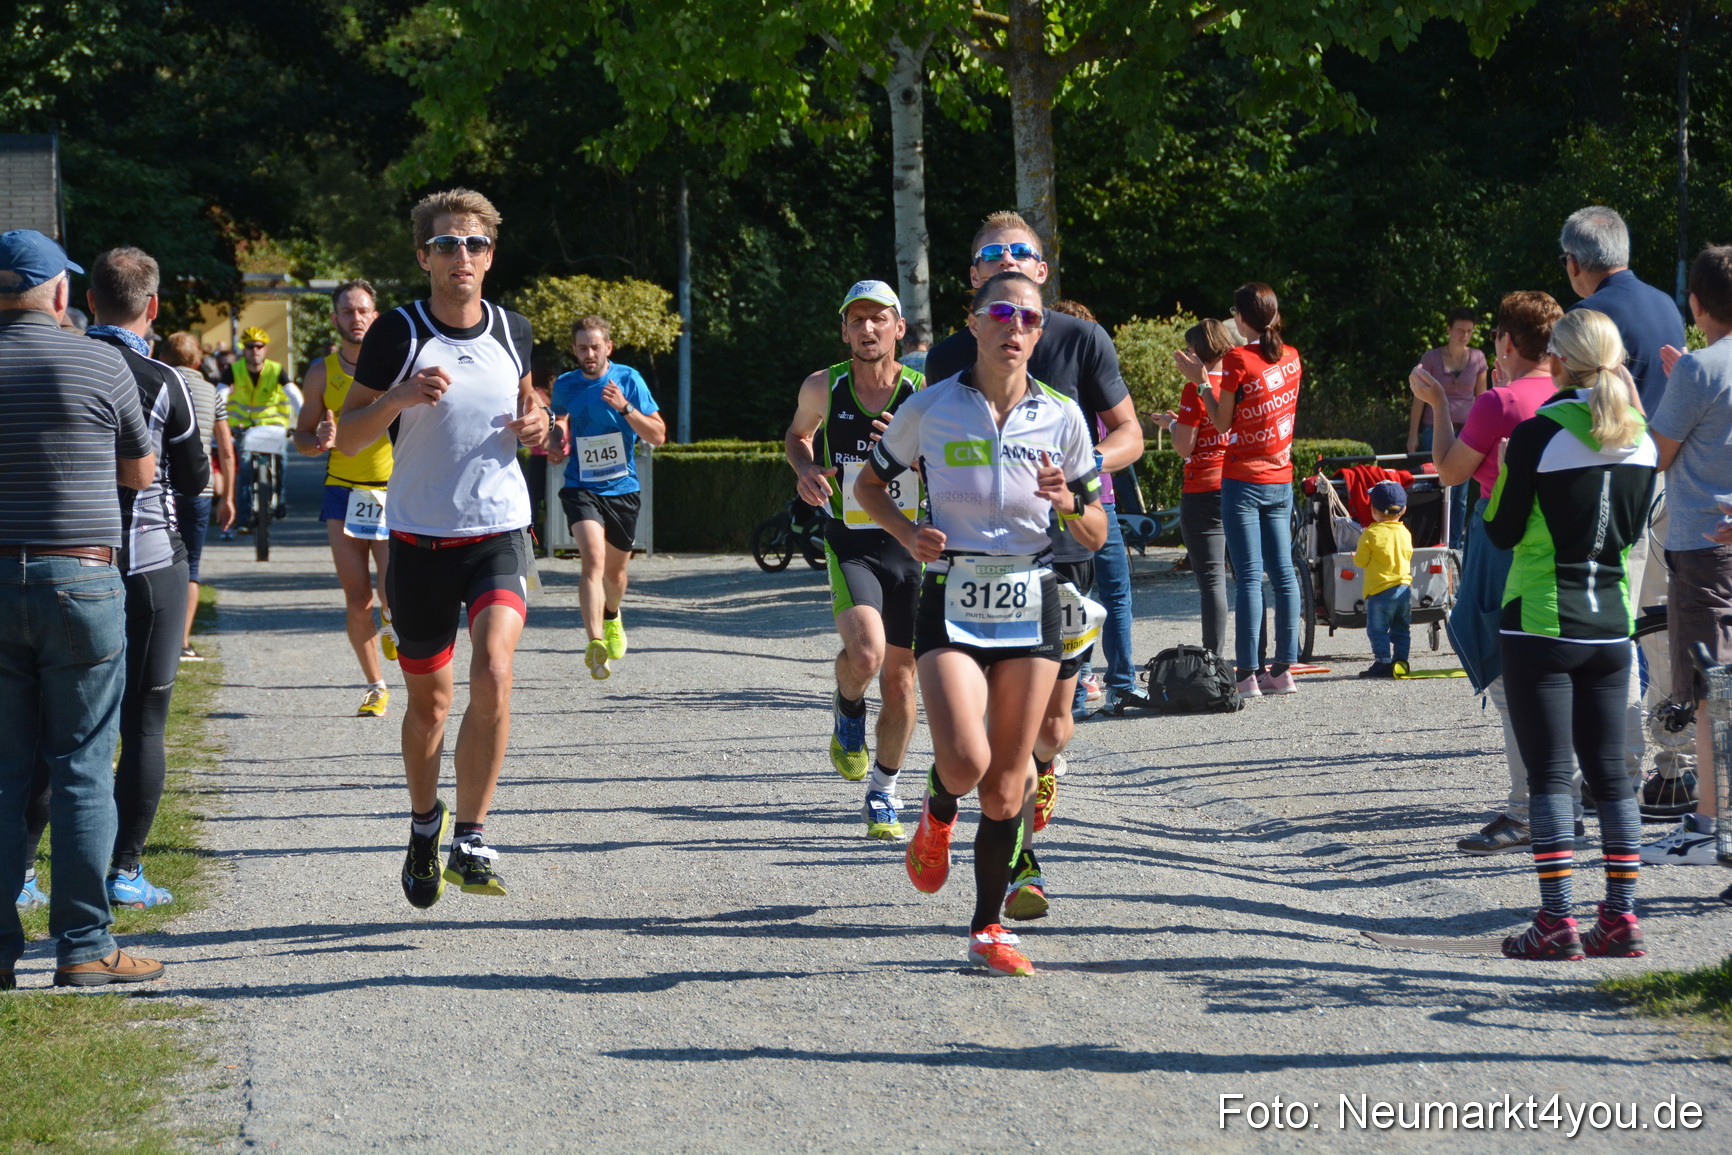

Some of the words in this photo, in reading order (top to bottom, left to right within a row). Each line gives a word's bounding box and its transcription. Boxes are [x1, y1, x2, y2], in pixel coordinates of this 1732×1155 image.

[584, 446, 618, 463] 2145
[955, 446, 984, 461] CIS
[355, 502, 384, 518] 217
[976, 565, 1015, 574] BOCK
[960, 581, 1027, 609] 3128
